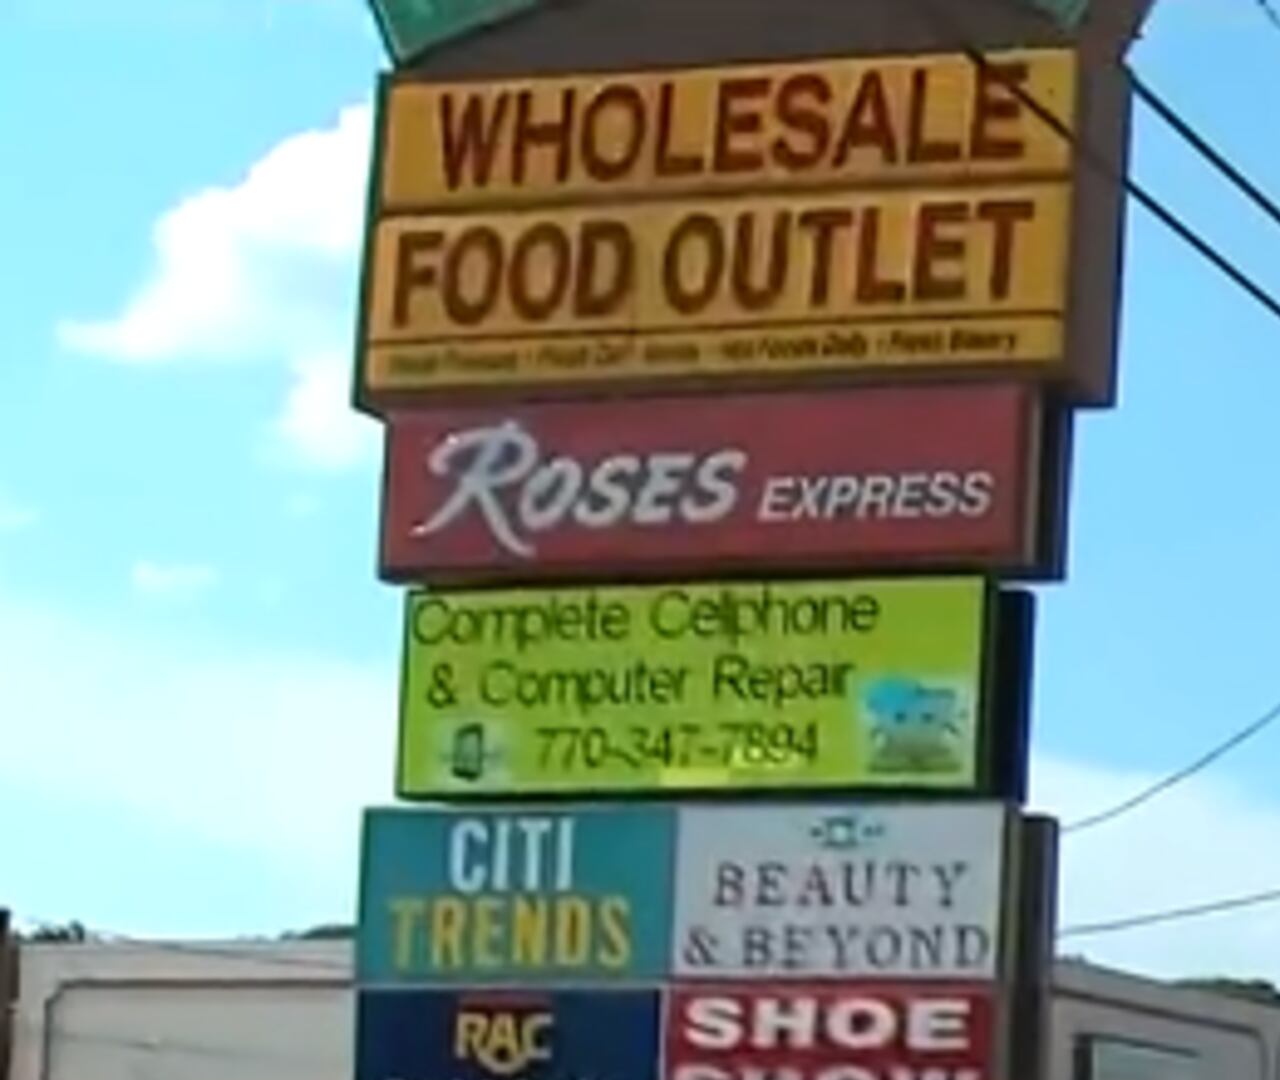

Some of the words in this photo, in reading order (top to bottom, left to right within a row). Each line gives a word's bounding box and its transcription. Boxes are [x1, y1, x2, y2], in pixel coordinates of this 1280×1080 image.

[439, 63, 1029, 191] WHOLESALE
[392, 221, 635, 328] FOOD
[662, 201, 1034, 314] OUTLET
[758, 473, 994, 521] EXPRESS
[412, 591, 630, 652] Complete
[427, 663, 457, 709] &
[480, 658, 692, 712] Computer
[713, 653, 854, 710] Repair
[533, 720, 818, 771] 770-347-7894
[449, 817, 574, 894] CITI
[716, 861, 971, 908] BEAUTY
[390, 895, 632, 969] TRENDS
[683, 925, 720, 966] &
[742, 923, 990, 970] BEYOND
[456, 1012, 554, 1074] RAC
[685, 998, 971, 1051] SHOE
